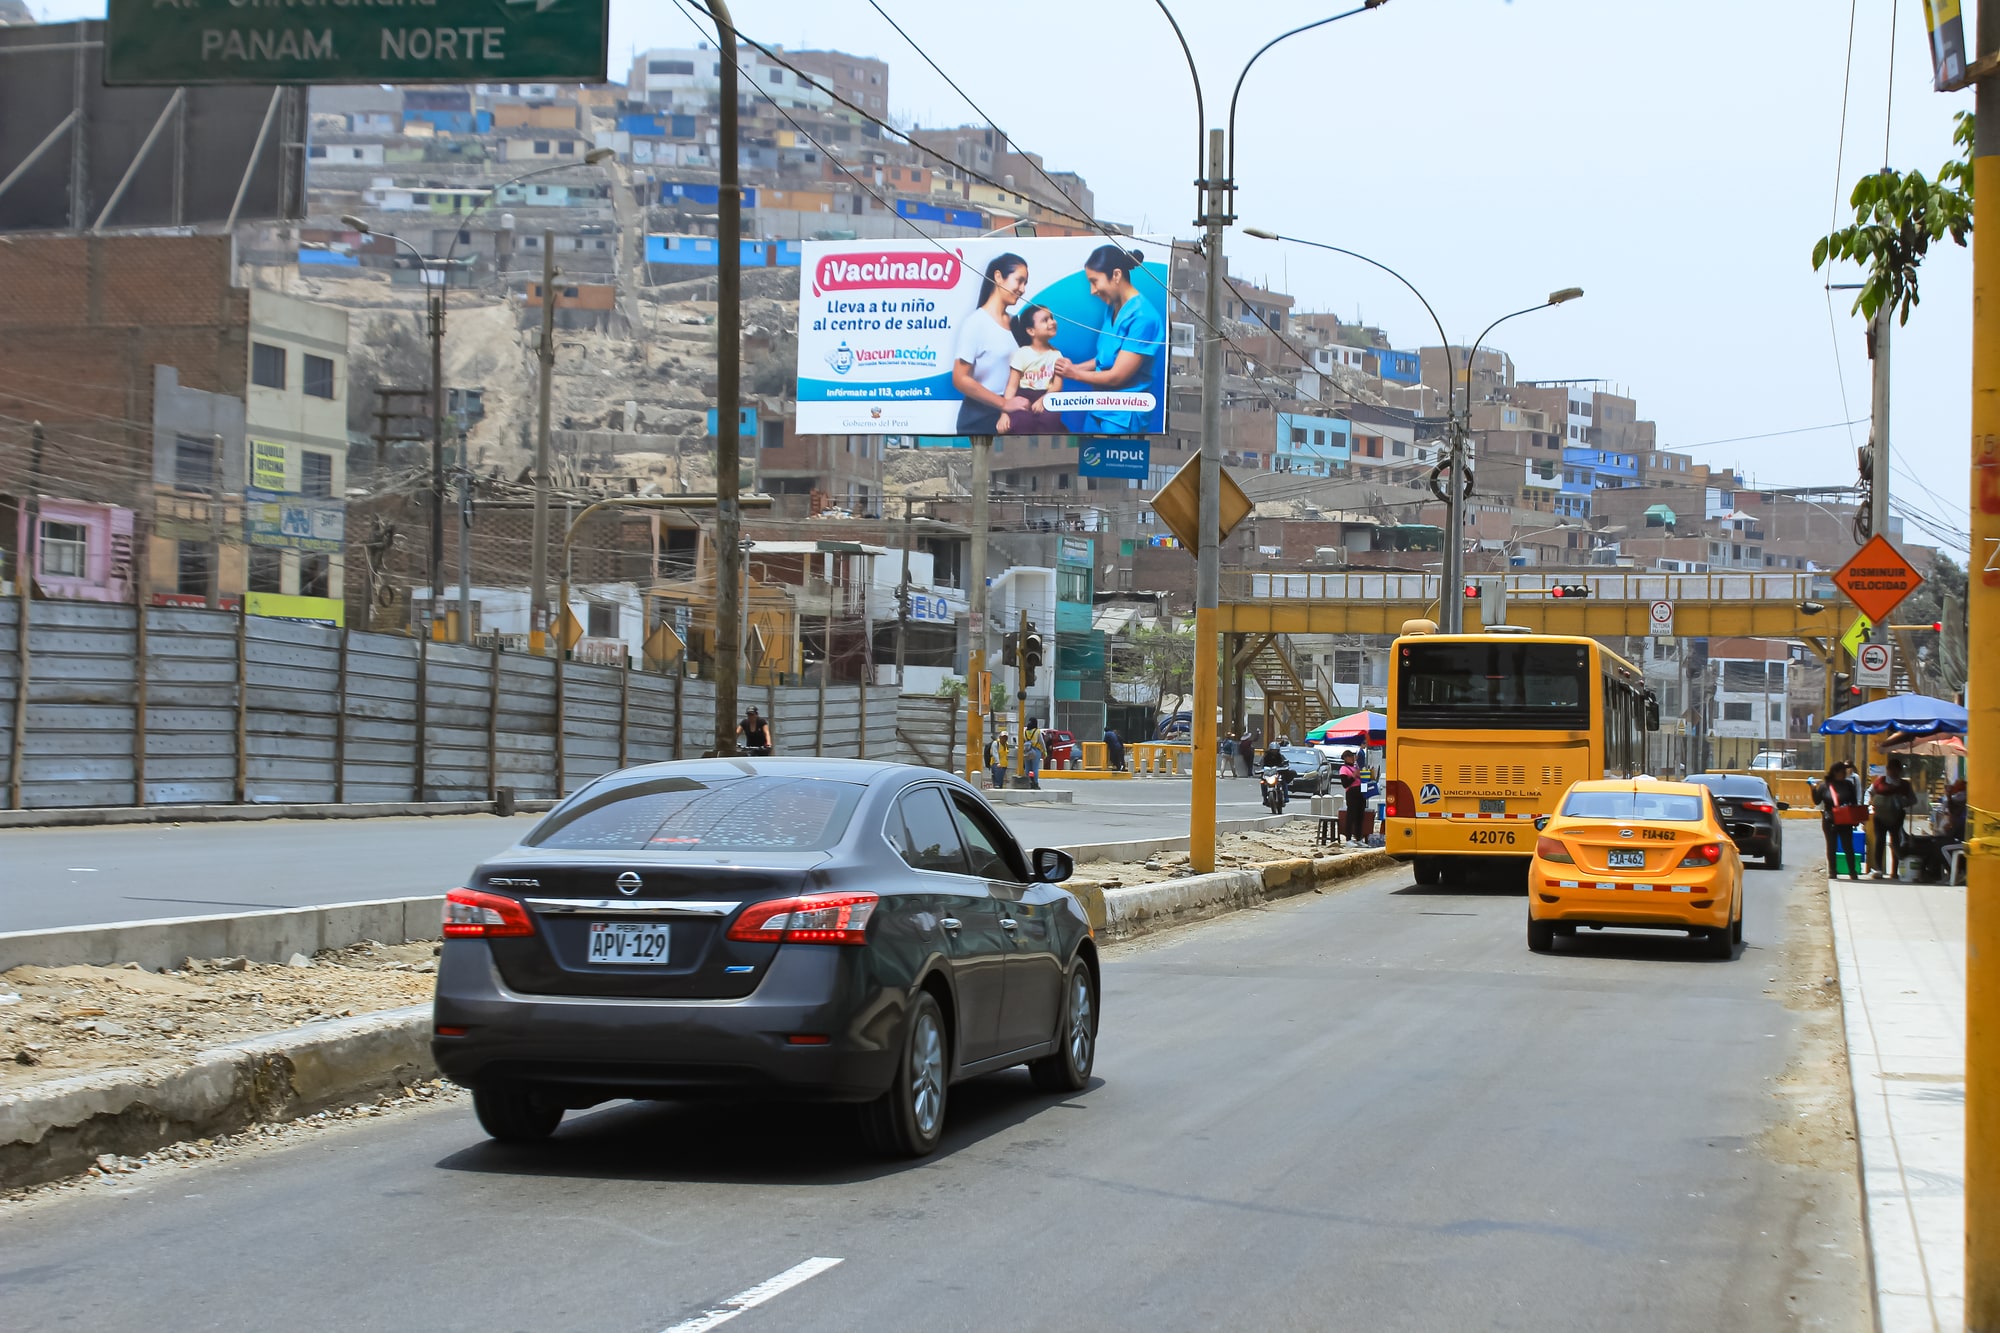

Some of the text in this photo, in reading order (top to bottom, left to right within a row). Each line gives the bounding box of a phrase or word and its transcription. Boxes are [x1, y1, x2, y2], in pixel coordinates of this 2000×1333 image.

[380, 27, 505, 60] NORTE
[823, 256, 954, 286] ¡Vacúnalo!
[827, 298, 935, 313] Lleva a tu niño
[813, 316, 951, 330] al centro de salud.
[855, 344, 937, 362] Vacunacción
[826, 386, 932, 398] Infórmate al 113, opción 3.
[1050, 395, 1149, 407] Tu acción salva vidas.
[842, 419, 908, 427] Gobierno del Perú
[1849, 568, 1906, 577] DISMINUIR
[1847, 581, 1908, 590] VELOCIDAD
[1469, 830, 1515, 844] 42076
[1609, 854, 1643, 865] F1A-462
[488, 877, 541, 887] SENTRA
[592, 933, 666, 957] APV-129
